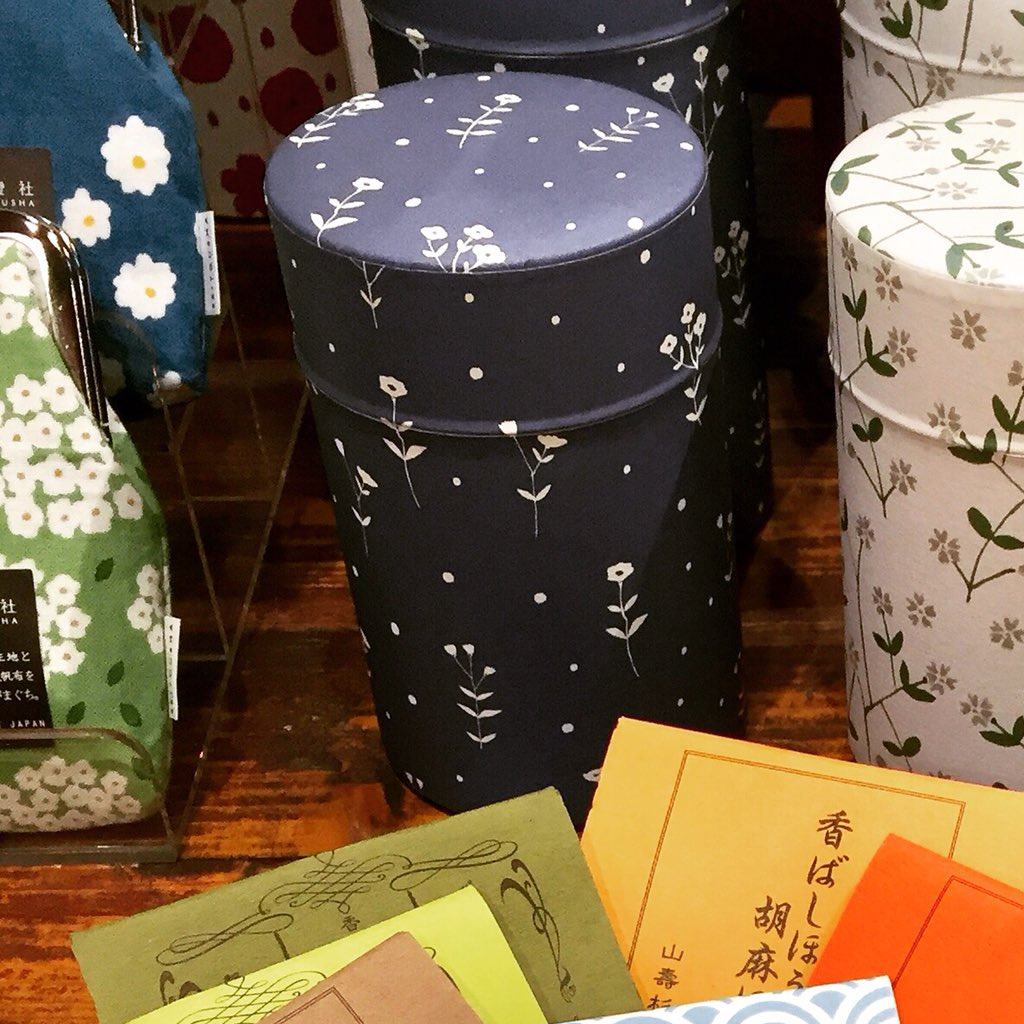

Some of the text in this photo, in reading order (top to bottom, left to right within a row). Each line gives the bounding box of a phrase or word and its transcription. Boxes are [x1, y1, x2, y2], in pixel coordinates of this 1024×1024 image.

[0, 671, 34, 682] 帆布を
[10, 721, 46, 729] JAPAN
[736, 895, 791, 996] 胡麻
